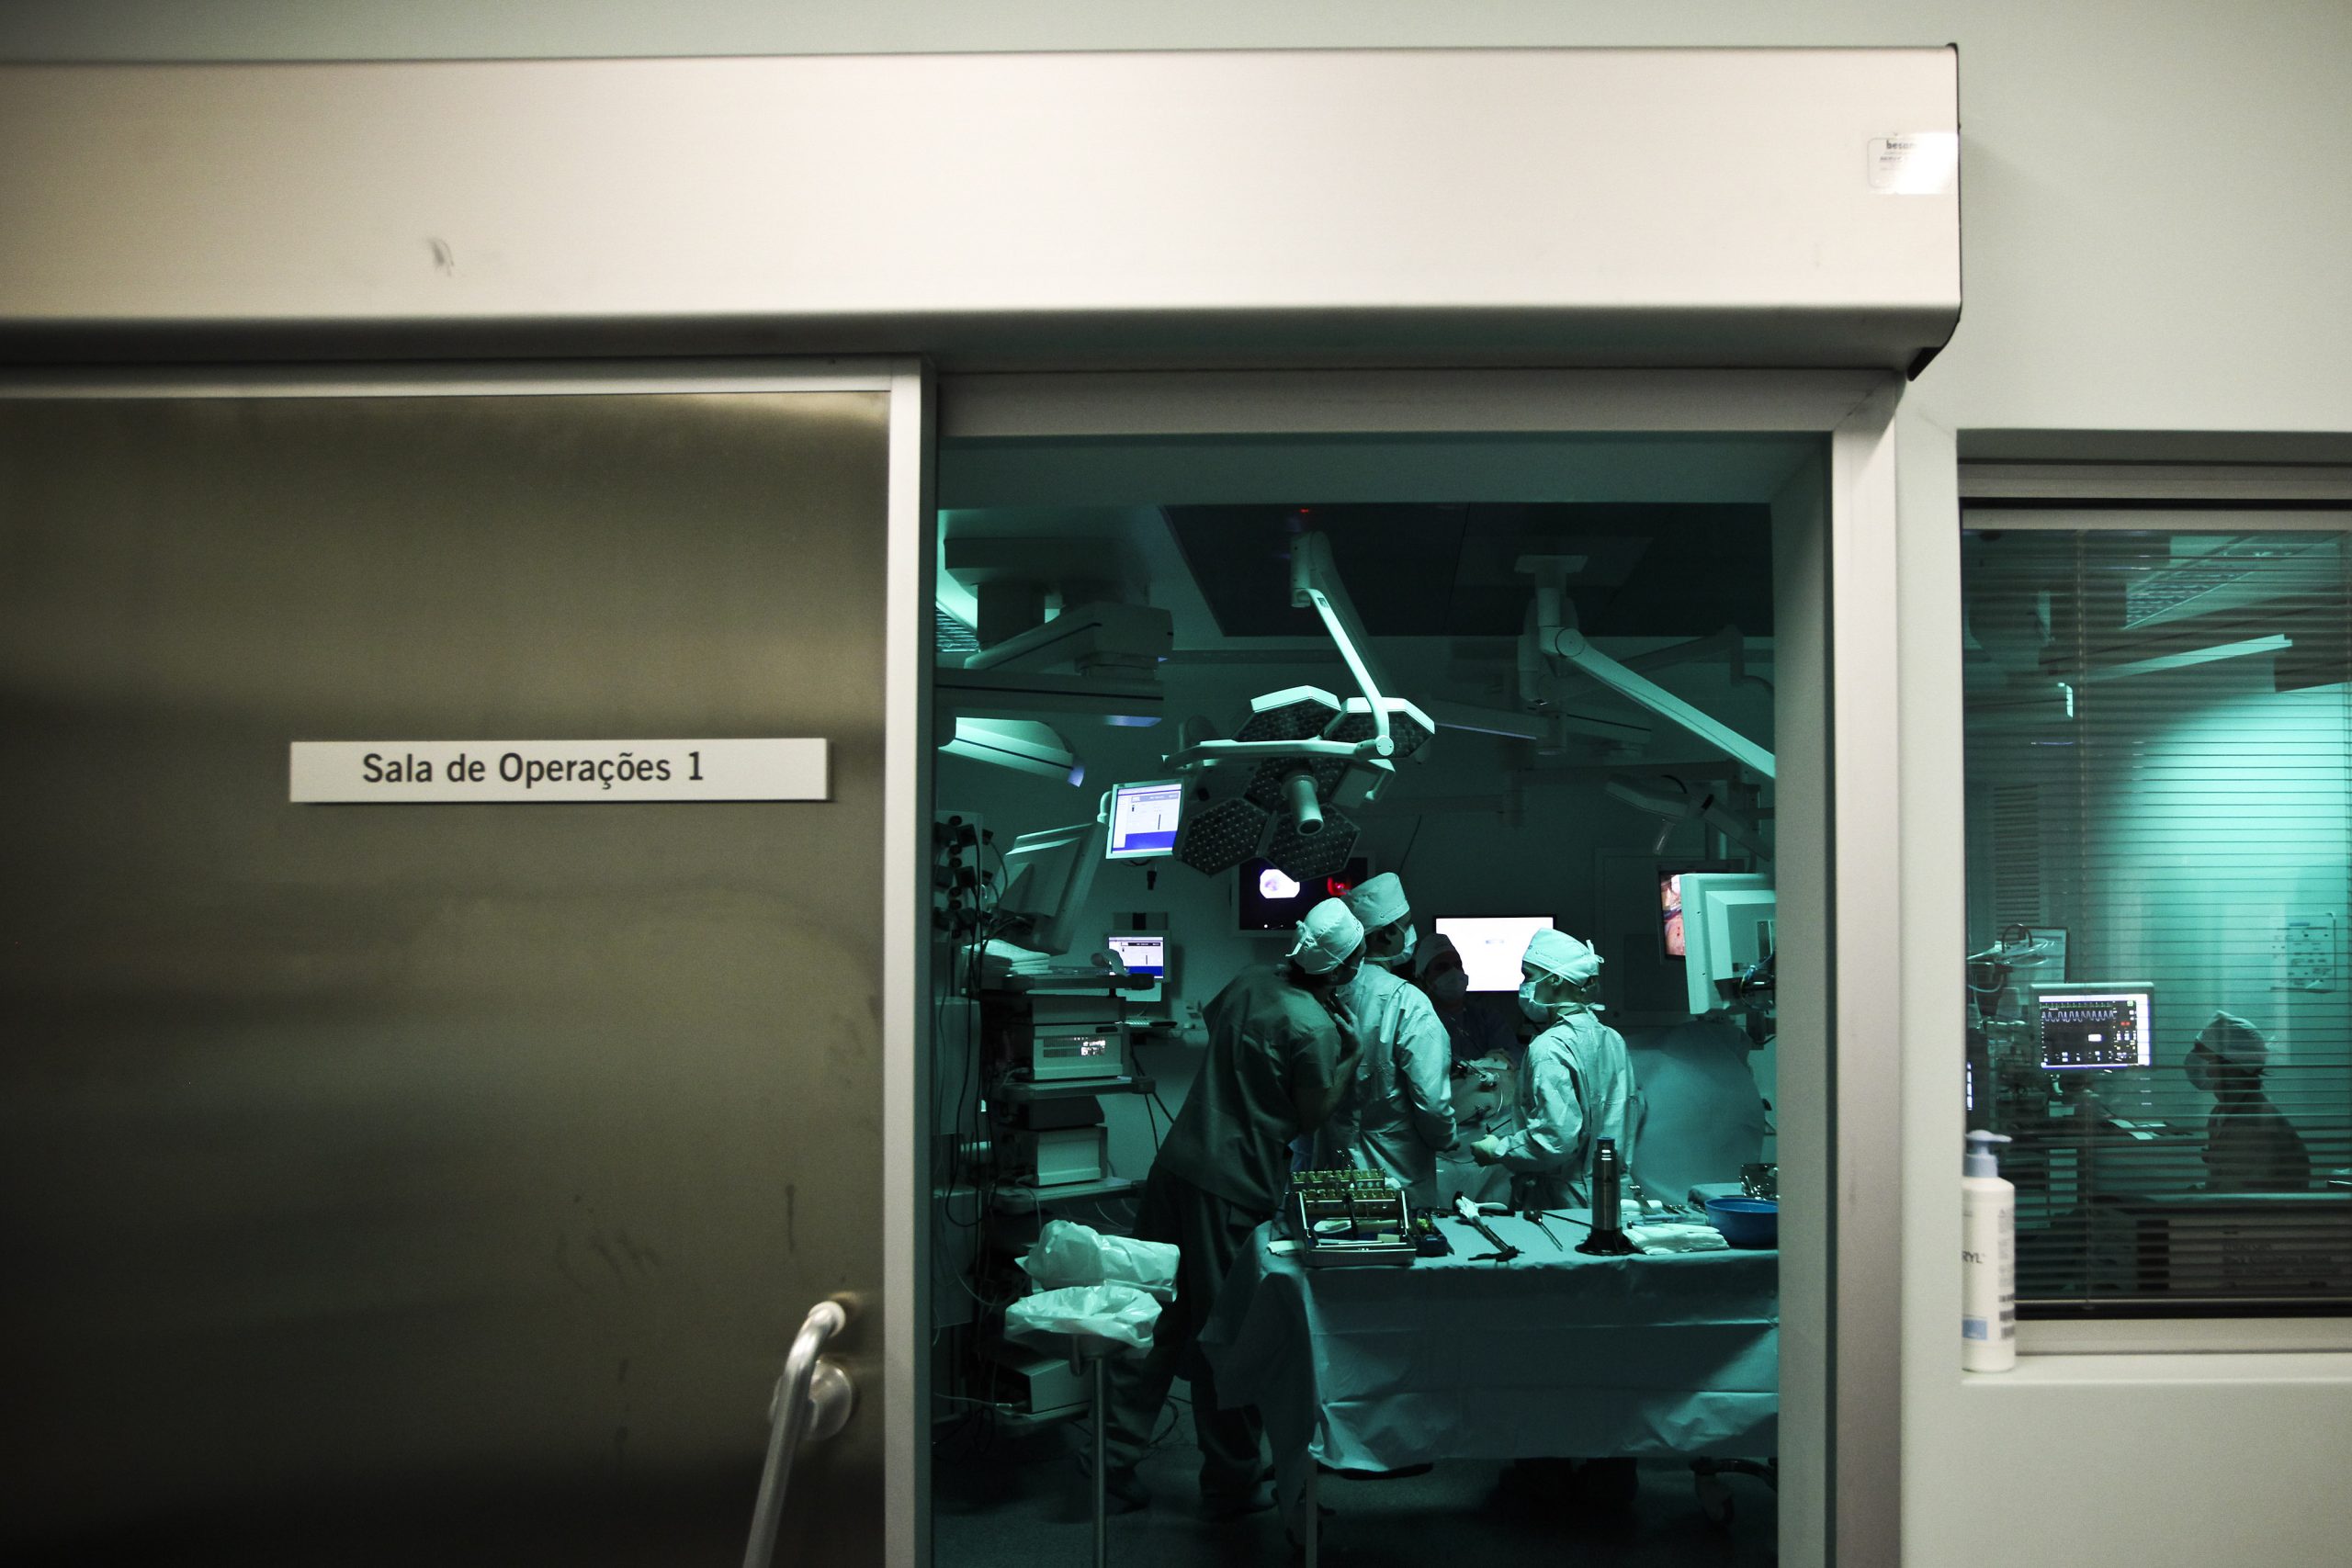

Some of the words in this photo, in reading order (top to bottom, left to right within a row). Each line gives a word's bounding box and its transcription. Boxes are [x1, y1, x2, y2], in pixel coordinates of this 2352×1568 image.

[362, 752, 433, 784] Sala
[447, 752, 486, 783] de
[499, 750, 671, 790] Operações
[688, 750, 704, 781] 1
